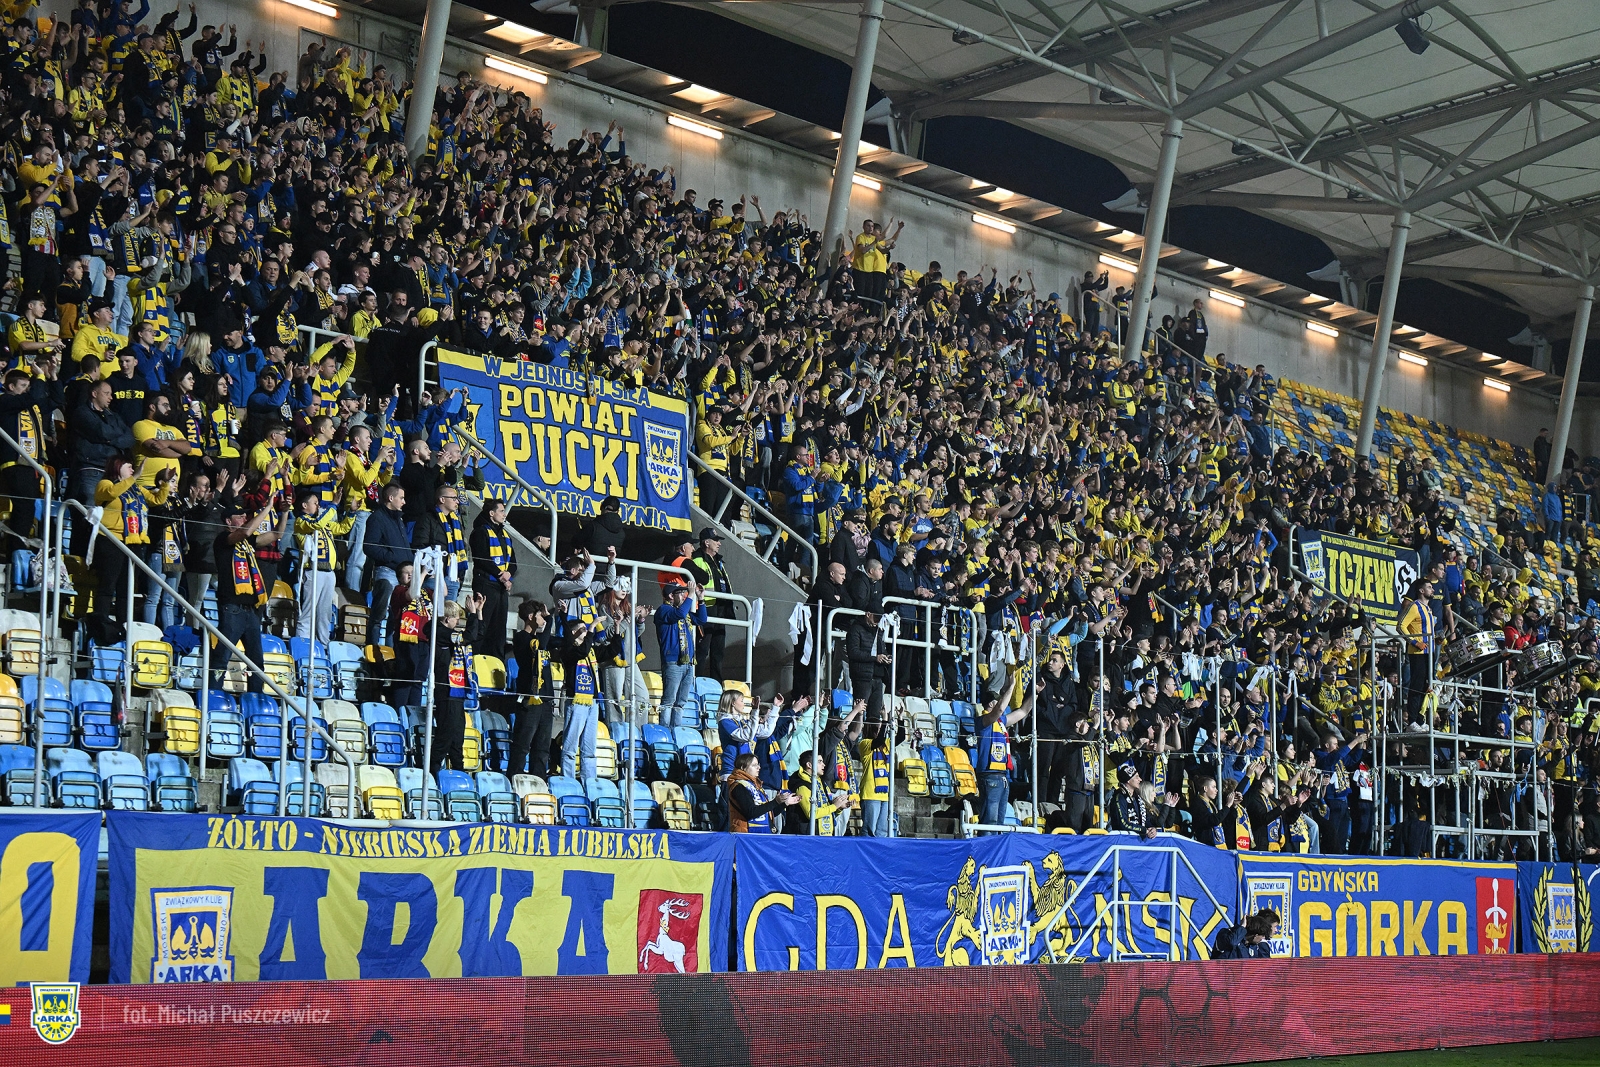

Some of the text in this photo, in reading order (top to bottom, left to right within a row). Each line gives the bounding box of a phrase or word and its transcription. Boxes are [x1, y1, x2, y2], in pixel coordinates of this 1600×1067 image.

[482, 354, 504, 378] W
[499, 384, 638, 437] POWIAT
[498, 420, 640, 501] PUCKI
[650, 462, 679, 477] ARKA
[1325, 547, 1395, 605] TCZEW
[319, 825, 461, 858] NIEBIESKA
[467, 824, 552, 856] ZIEMIA
[556, 829, 671, 860] LUBELSKA
[1297, 867, 1380, 893] GDYŃSKA
[205, 895, 223, 904] KLUB
[160, 912, 169, 959] MORSKI
[258, 865, 615, 981] ARKA
[1298, 892, 1469, 957] GÓRKA
[1552, 929, 1576, 940] ARKA
[1267, 940, 1286, 955] RKA
[164, 965, 223, 982] ARKA
